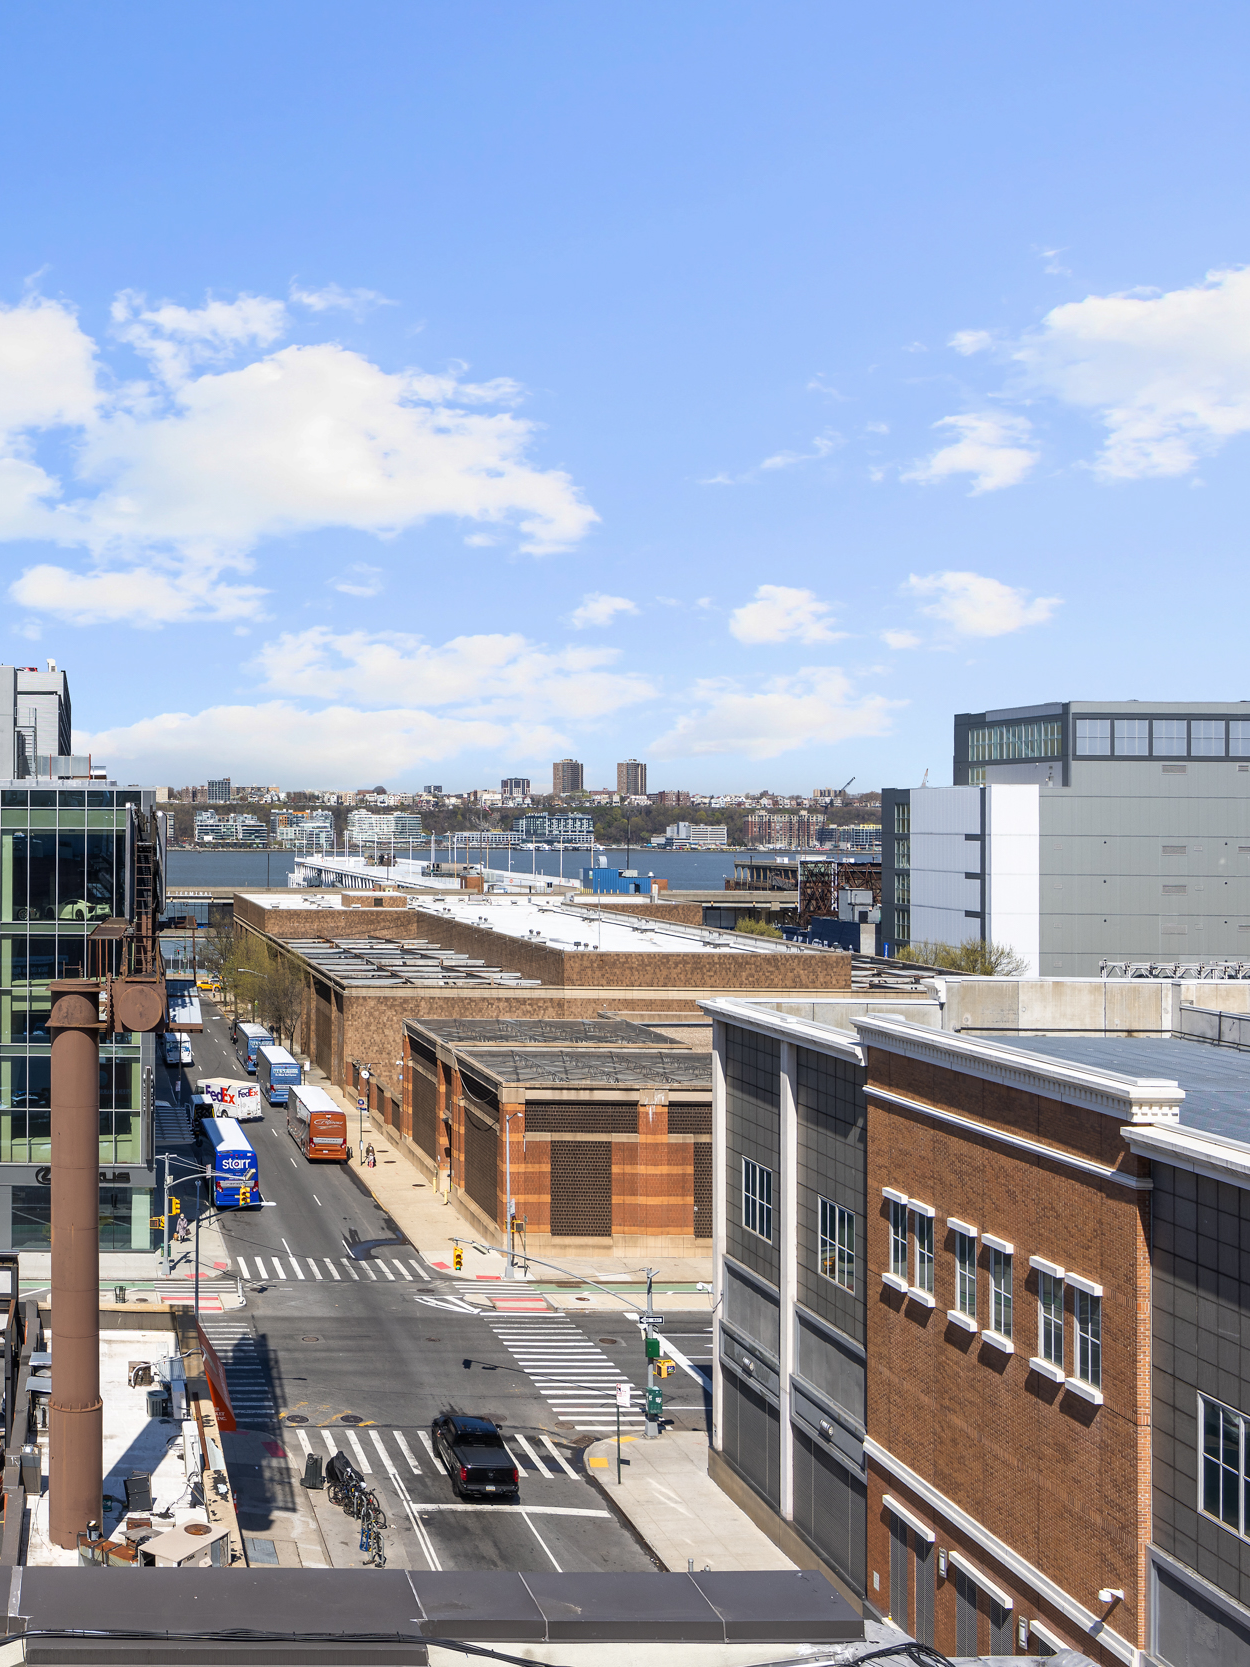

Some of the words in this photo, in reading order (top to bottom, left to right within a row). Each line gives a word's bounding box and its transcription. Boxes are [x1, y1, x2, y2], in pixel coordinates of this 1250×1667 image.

[205, 1085, 236, 1105] FedEx
[238, 1088, 259, 1098] FedEx
[222, 1158, 251, 1169] starr
